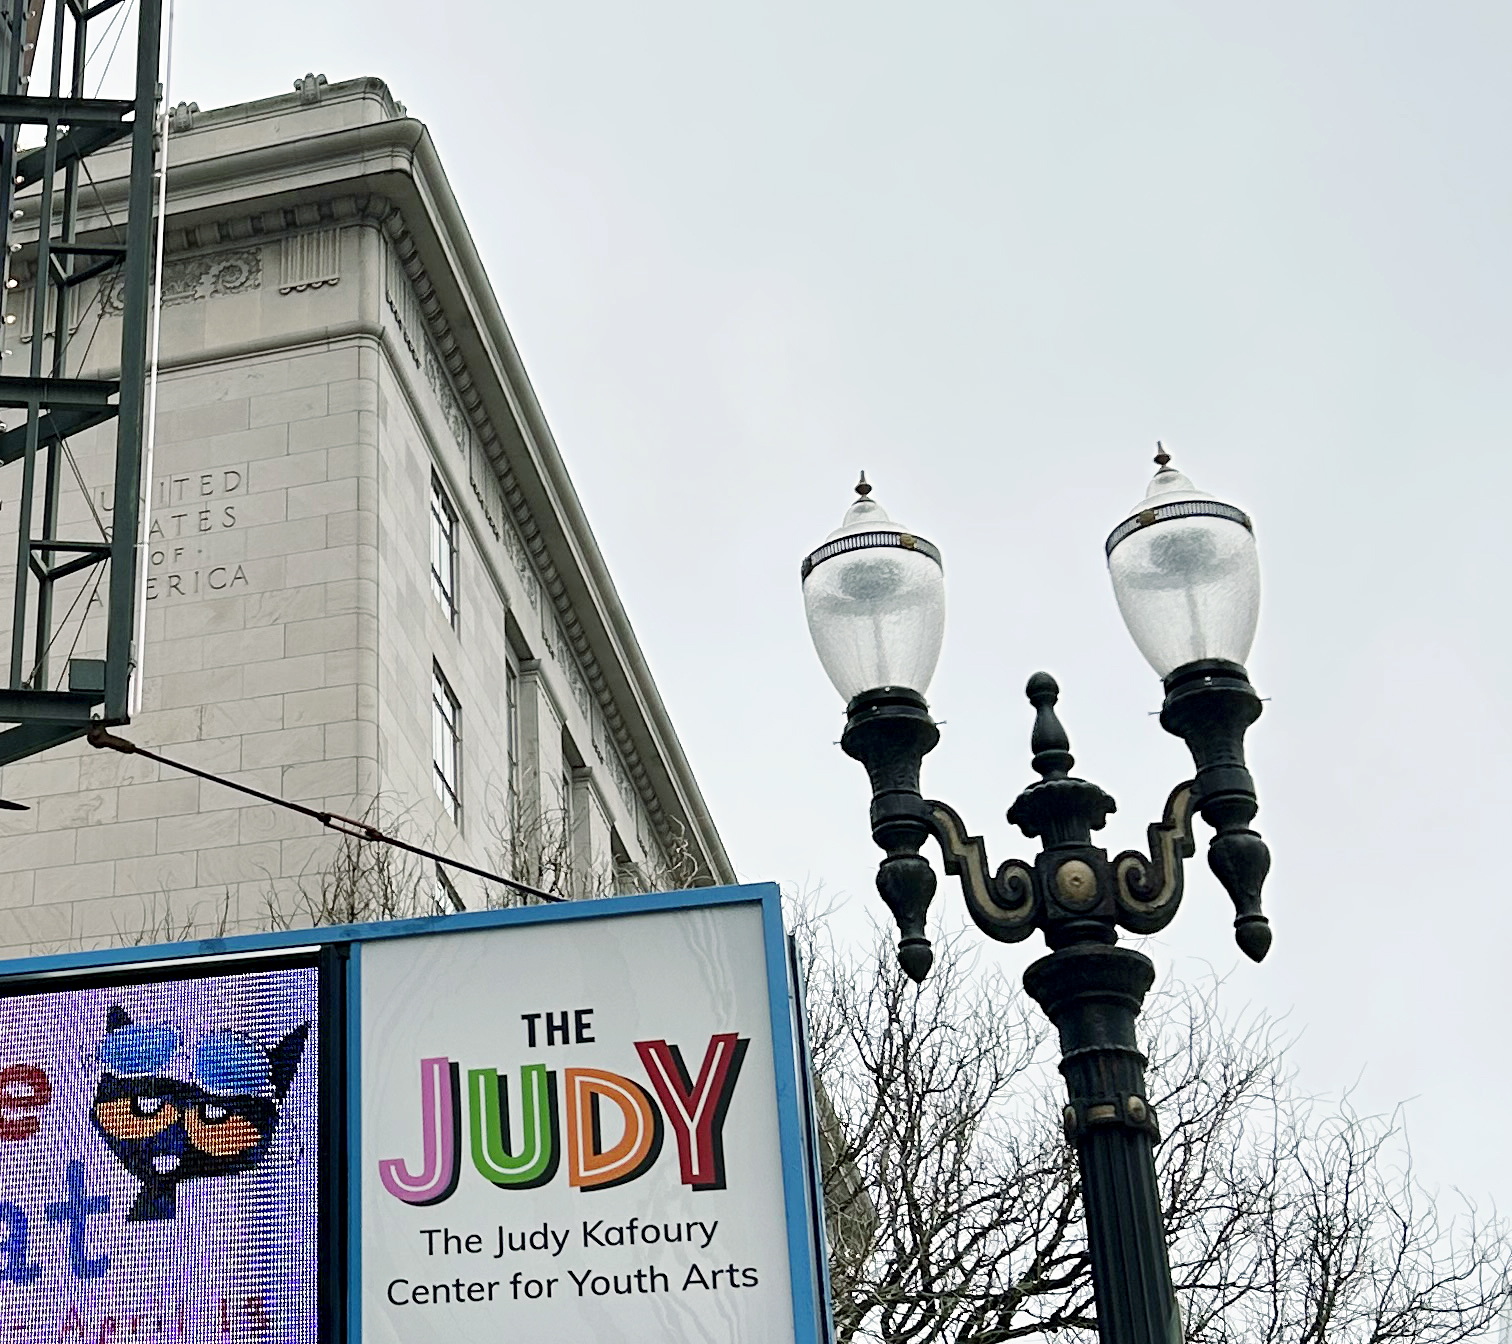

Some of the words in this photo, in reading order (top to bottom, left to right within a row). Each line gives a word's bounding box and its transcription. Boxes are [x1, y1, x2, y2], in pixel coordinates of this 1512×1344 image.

[101, 470, 242, 511] UITED
[151, 547, 185, 565] OF
[88, 564, 249, 608] AERICA
[521, 1009, 595, 1048] THE
[378, 1032, 750, 1207] JUDY
[420, 1228, 483, 1256] The
[494, 1221, 570, 1259] Judy
[582, 1217, 718, 1250] Kafoury
[387, 1277, 499, 1306] Center
[509, 1272, 559, 1301] for
[568, 1265, 670, 1298] Youth
[682, 1261, 759, 1292] Arts
